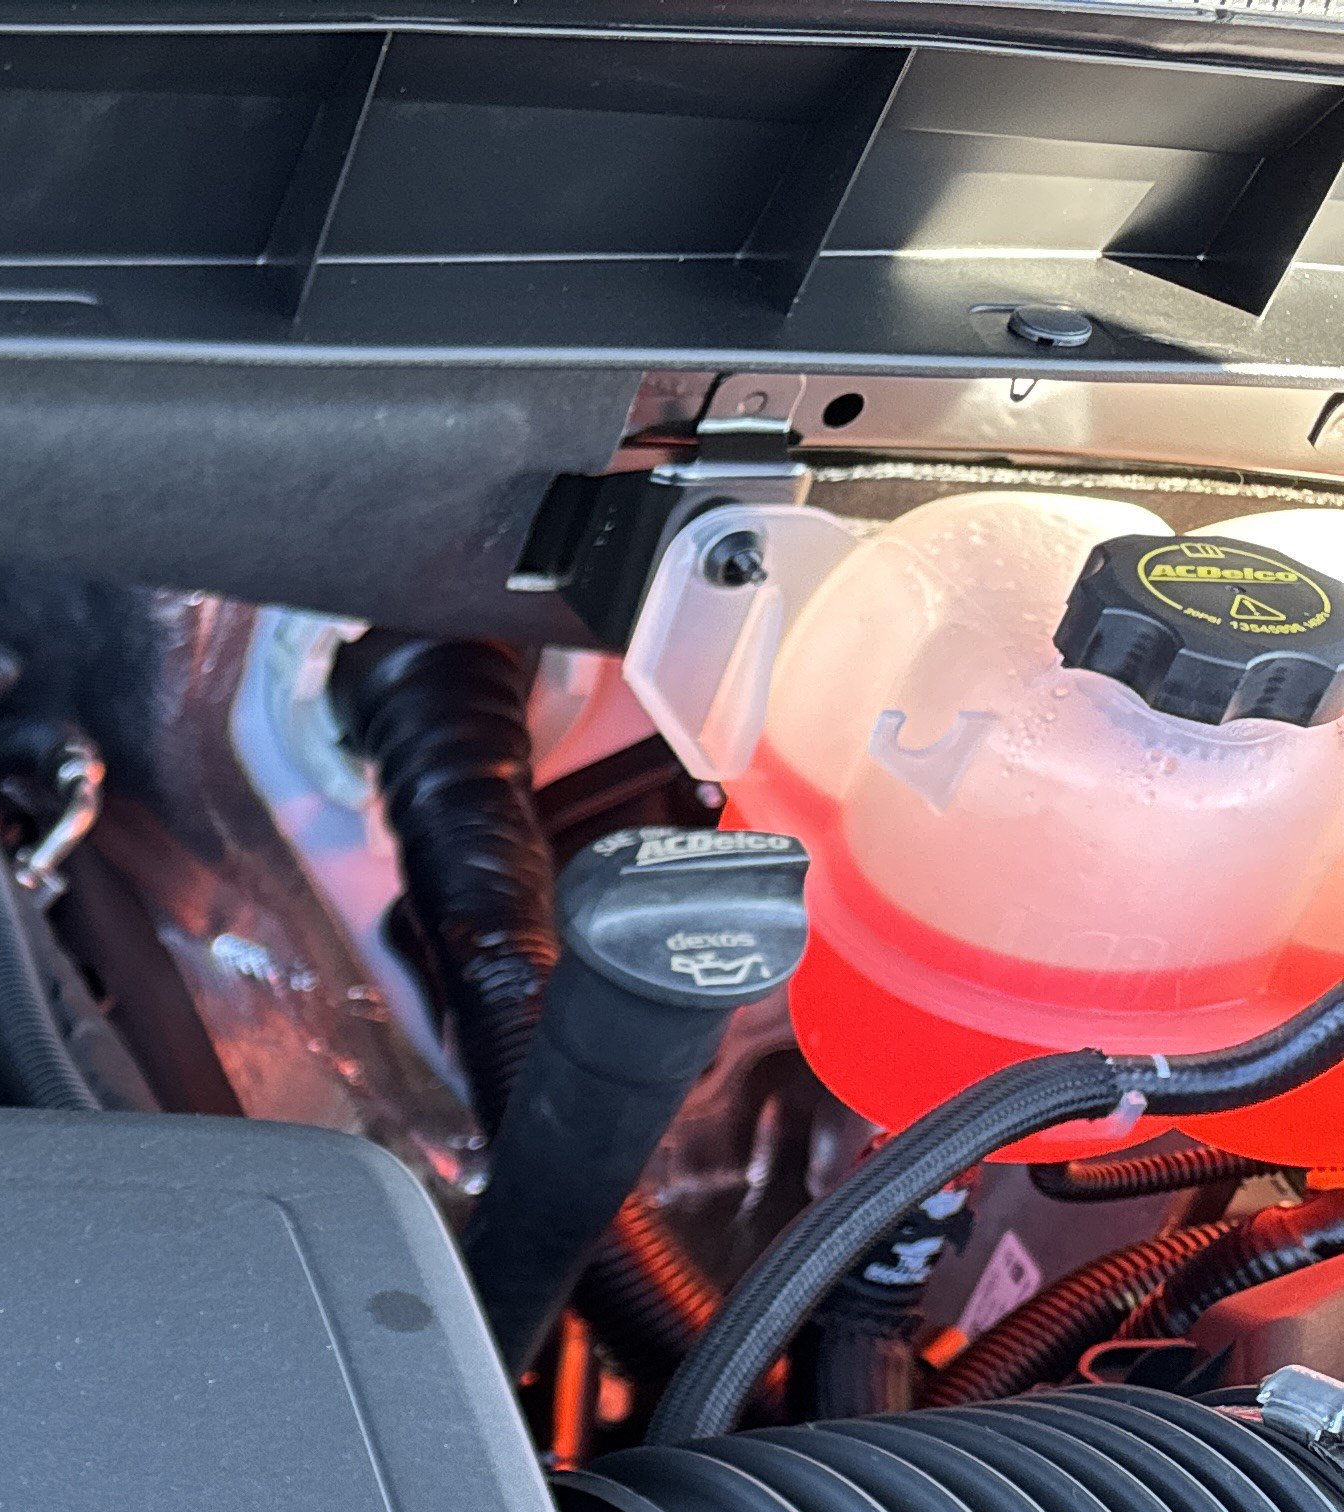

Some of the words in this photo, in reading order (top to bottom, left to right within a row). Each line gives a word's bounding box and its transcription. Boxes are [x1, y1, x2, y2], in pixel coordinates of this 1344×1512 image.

[1150, 564, 1298, 581] ACDelco
[637, 831, 790, 861] ACDelco
[666, 932, 757, 951] dexos
